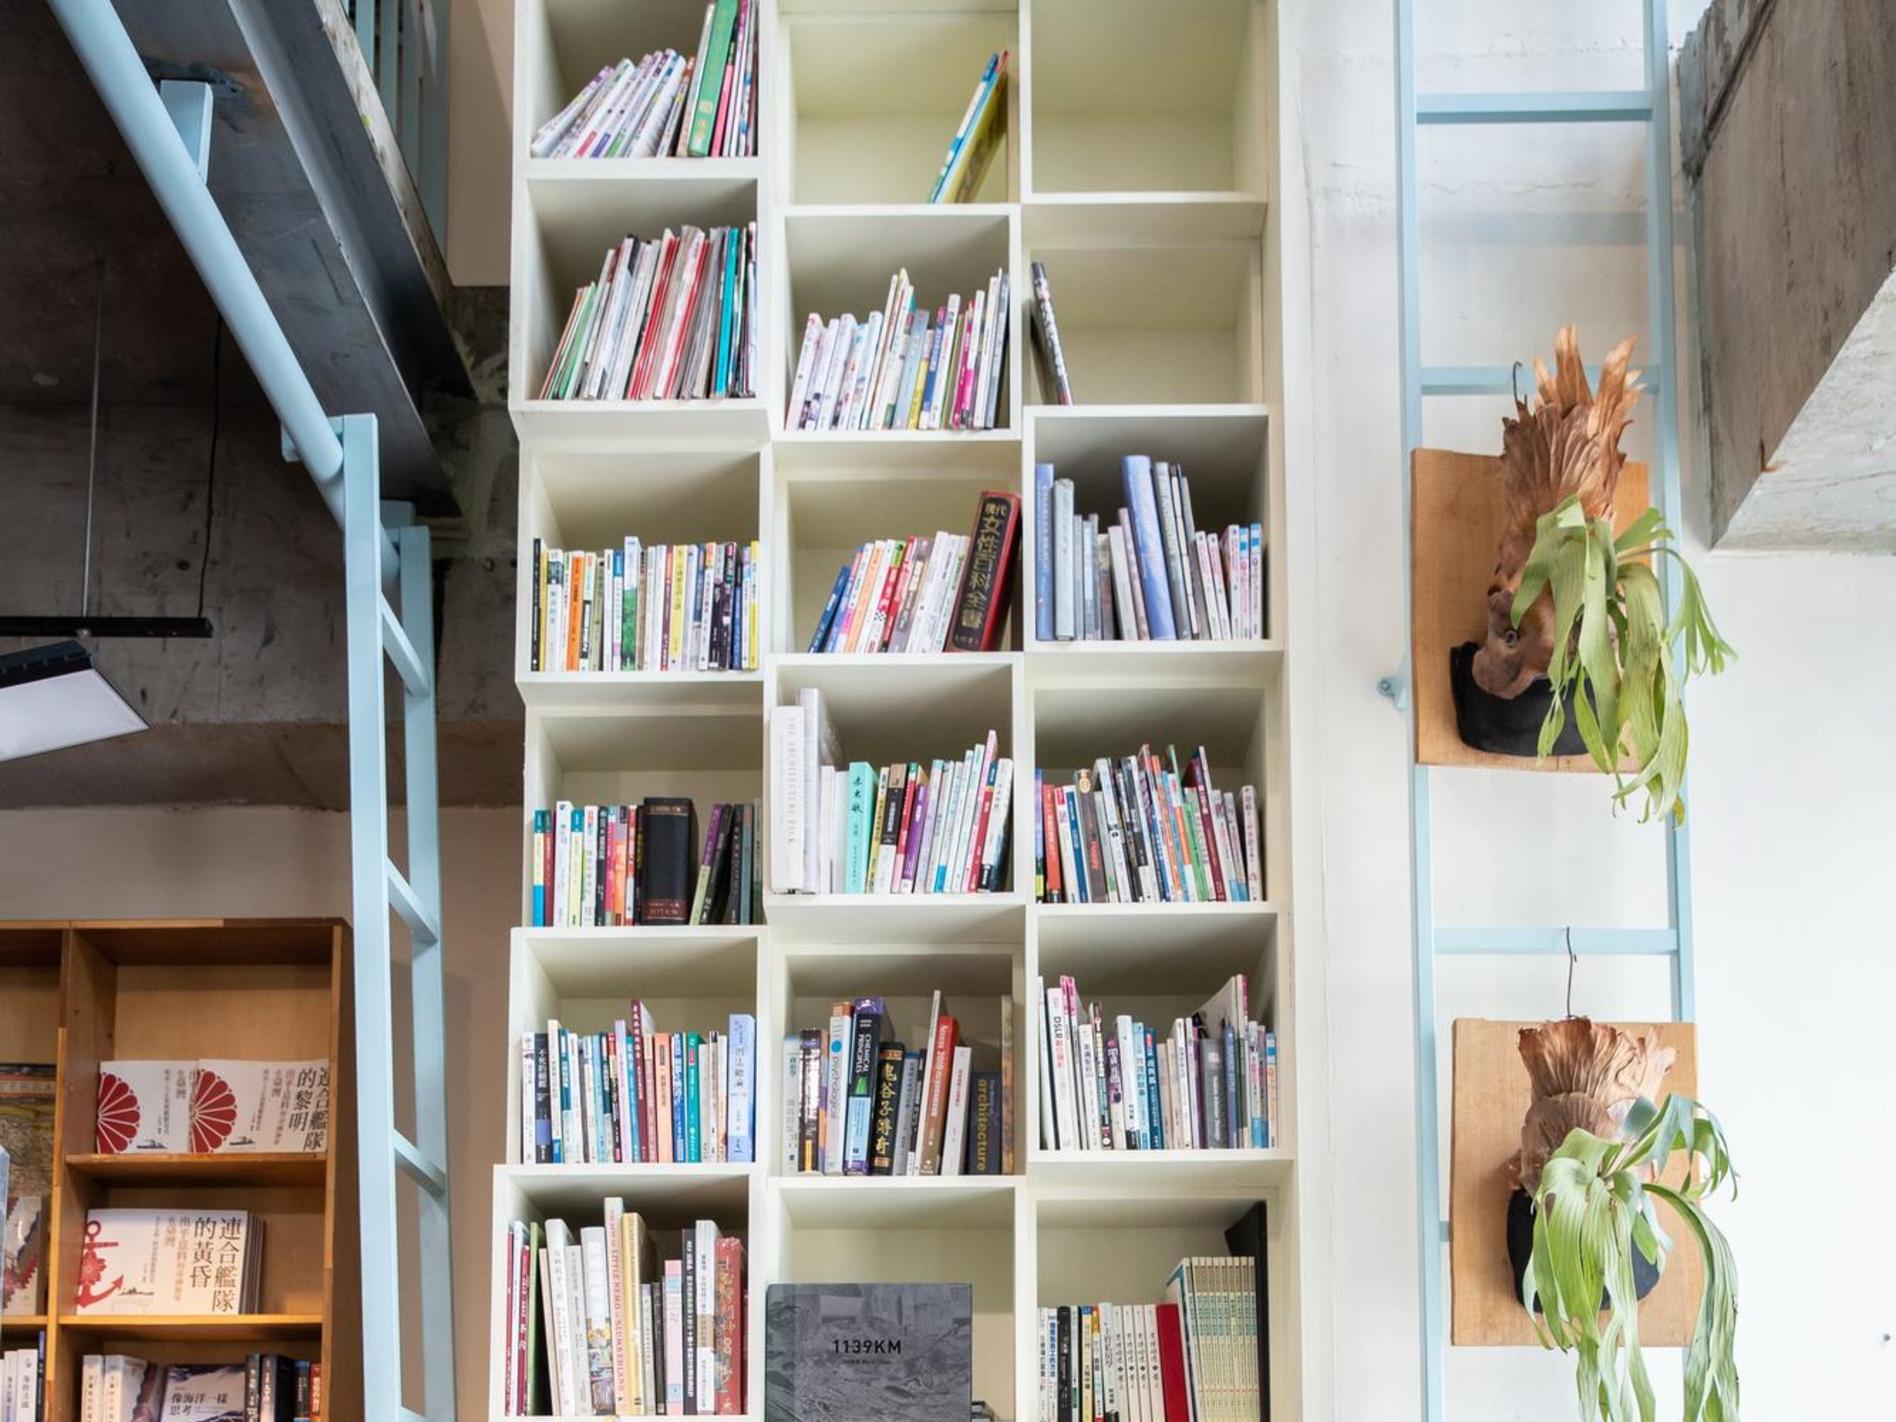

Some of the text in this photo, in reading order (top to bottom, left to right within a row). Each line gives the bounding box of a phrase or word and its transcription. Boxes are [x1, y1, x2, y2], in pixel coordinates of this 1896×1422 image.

[1053, 1016, 1064, 1039] DSLR
[289, 1068, 316, 1132] 的黎明
[976, 1079, 988, 1172] architecture
[190, 1216, 216, 1288] 的黃昏
[213, 1217, 242, 1312] 連合艦隊
[832, 1339, 902, 1355] 1139KM
